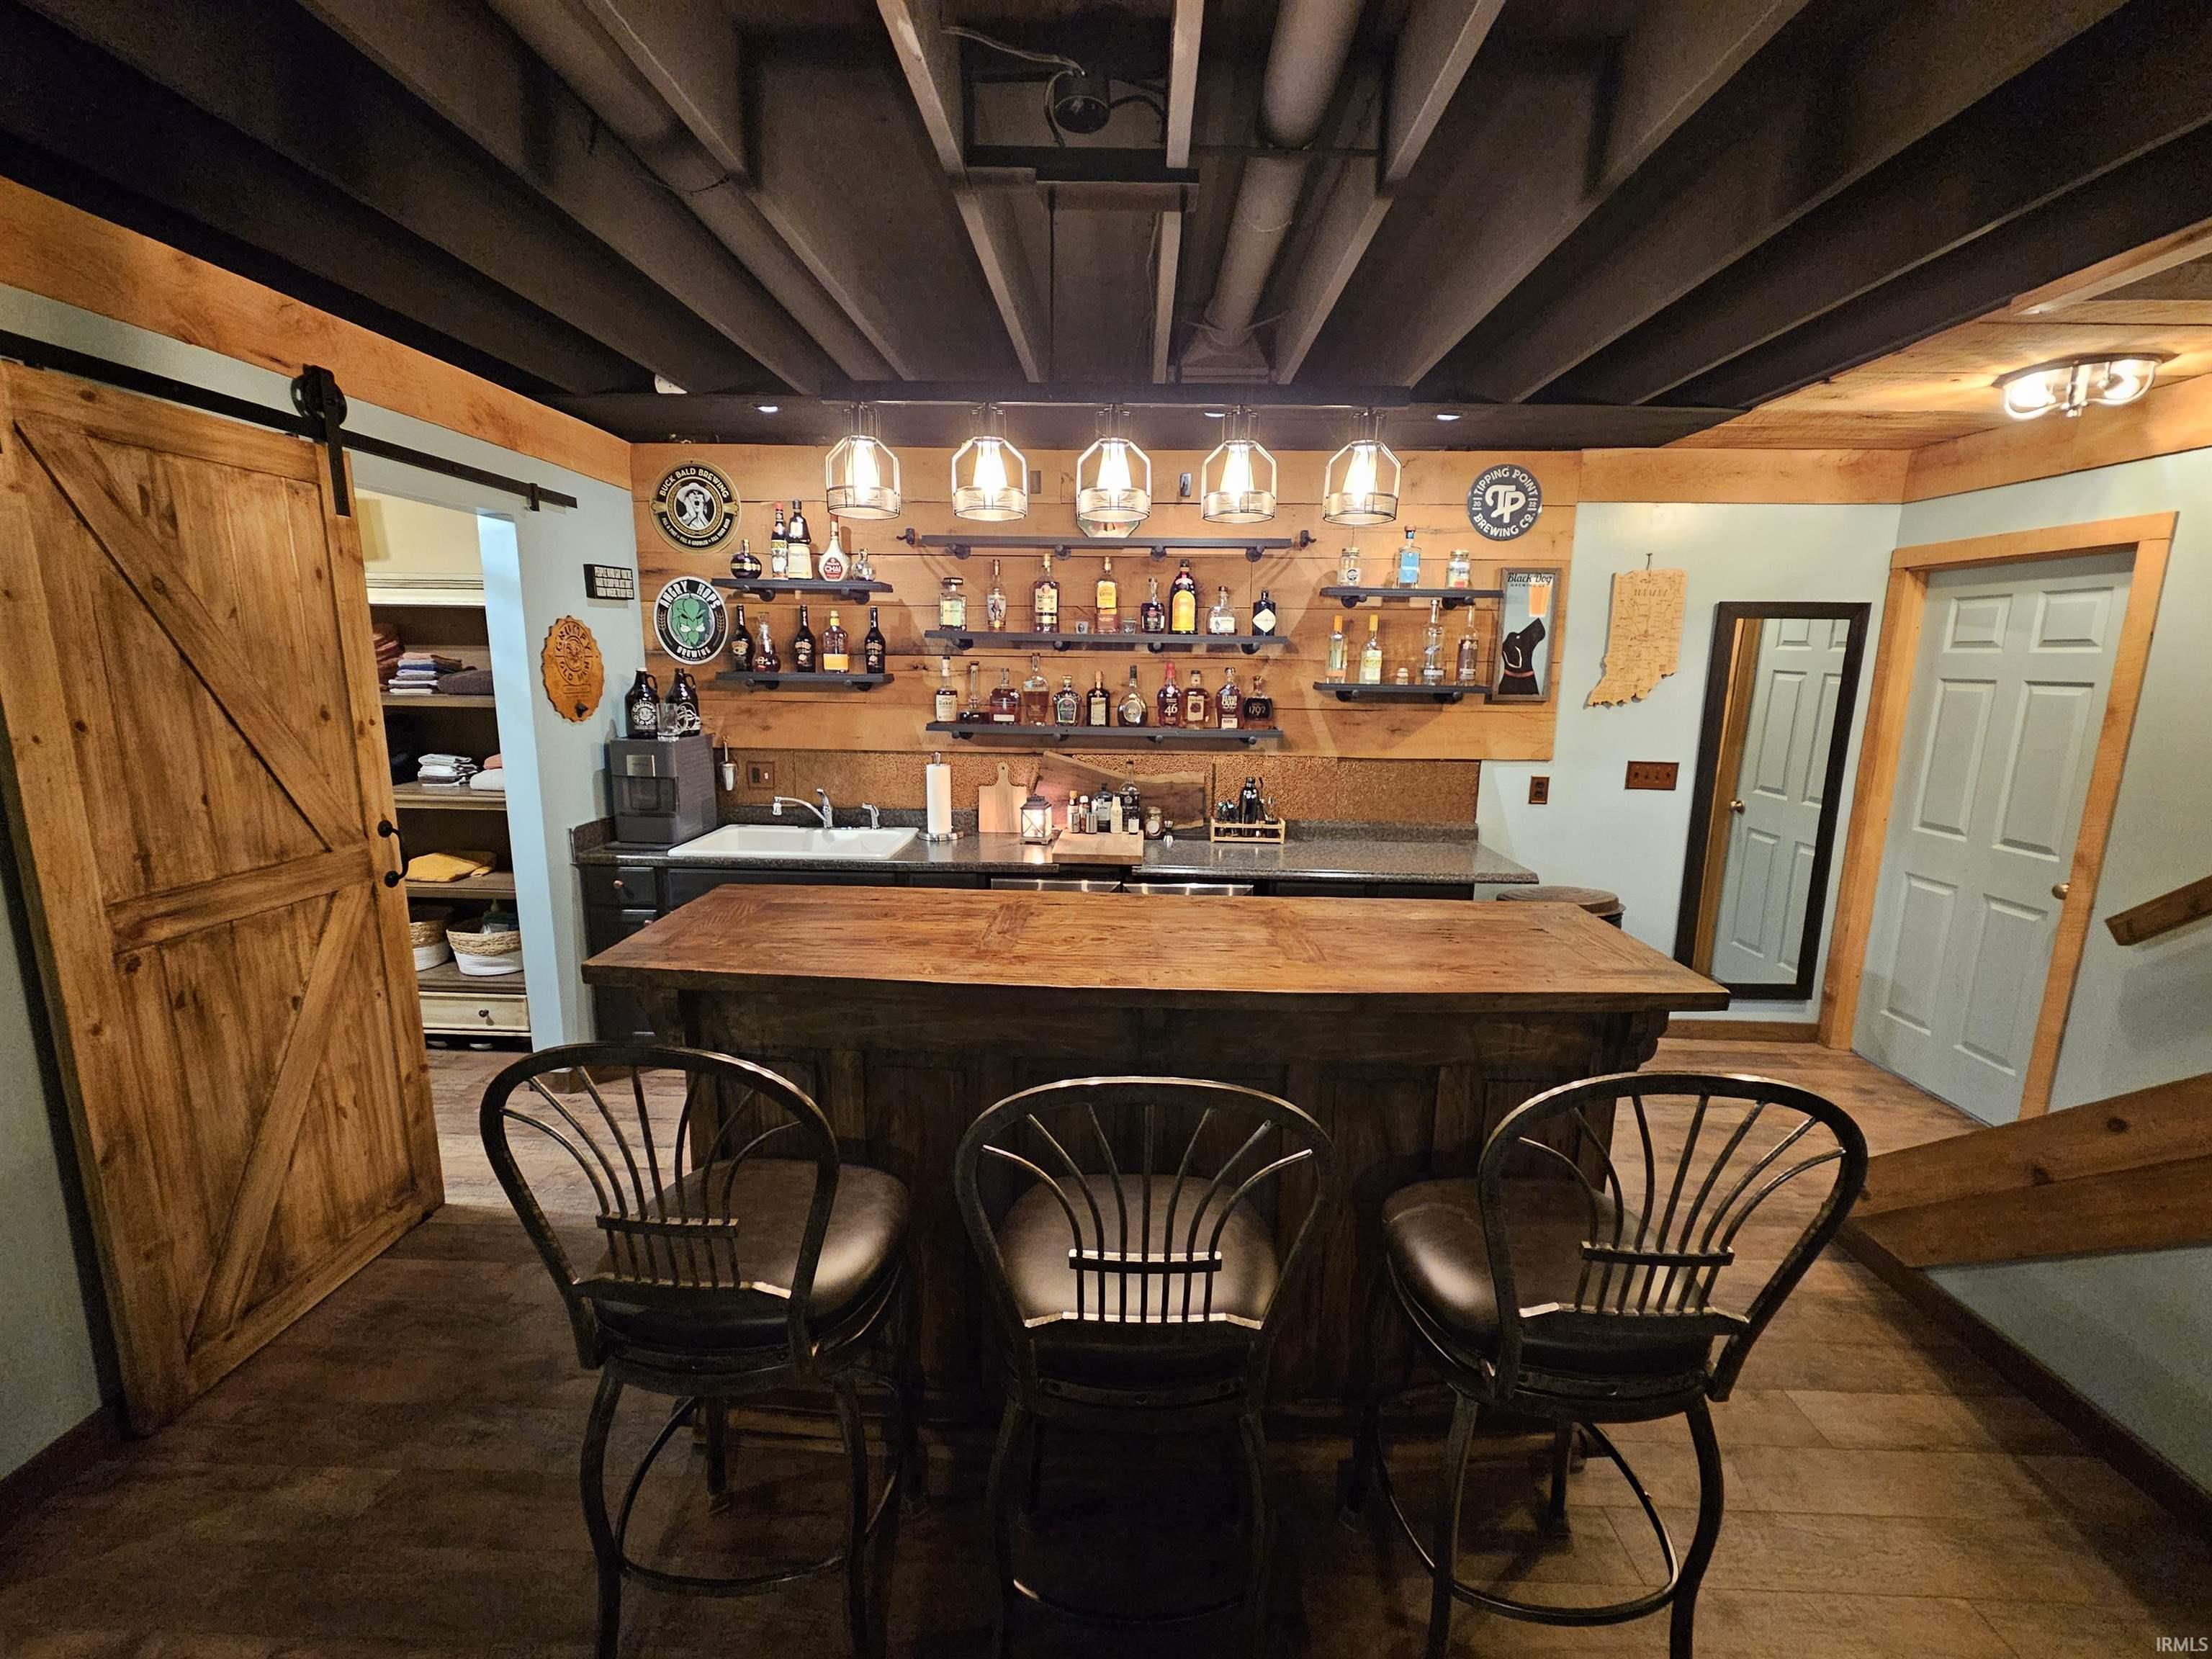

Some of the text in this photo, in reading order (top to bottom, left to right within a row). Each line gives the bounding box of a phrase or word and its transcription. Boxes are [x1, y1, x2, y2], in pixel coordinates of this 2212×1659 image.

[660, 468, 729, 498] BUCK BALD BREWING
[1473, 468, 1538, 495] TIPPING POINT
[1473, 513, 1519, 537] BREWING
[1507, 573, 1552, 585] Black Dog
[659, 581, 688, 608] ANGRY
[696, 583, 721, 609] HOPS
[559, 661, 573, 680] OLD
[1164, 703, 1178, 716] 46
[1249, 706, 1267, 716] 1792
